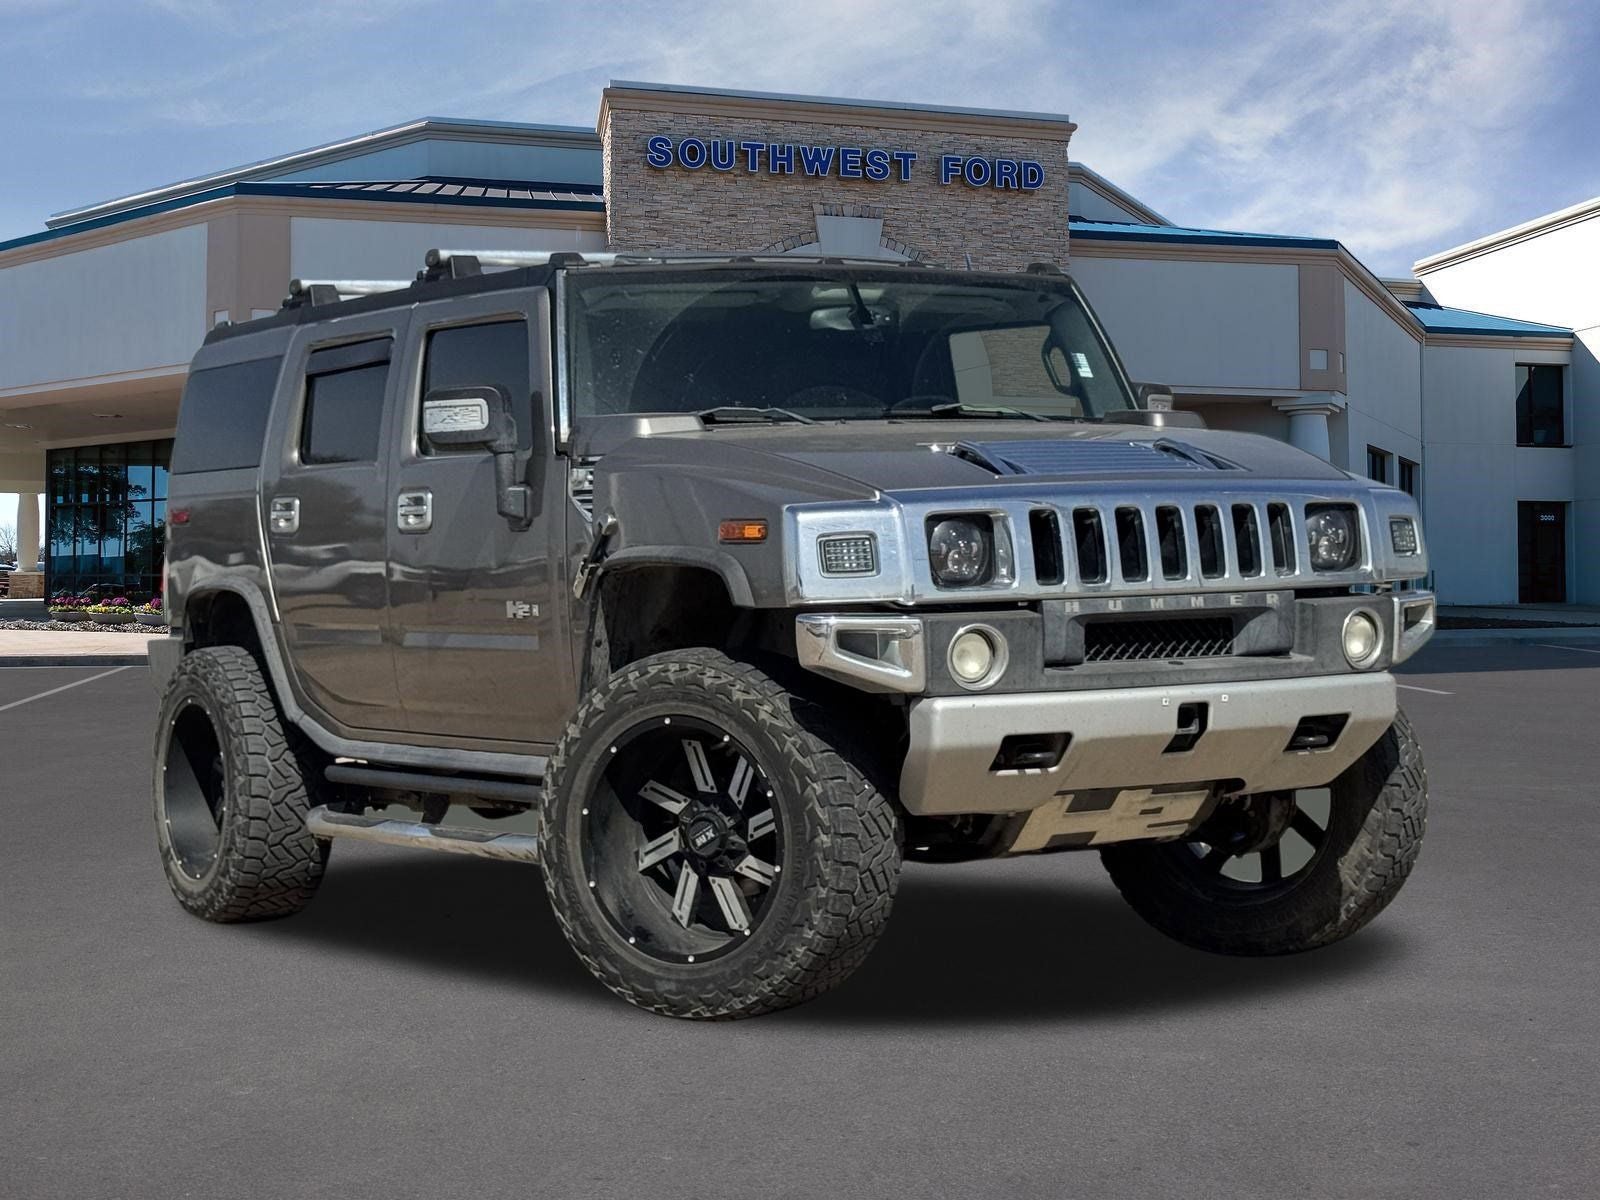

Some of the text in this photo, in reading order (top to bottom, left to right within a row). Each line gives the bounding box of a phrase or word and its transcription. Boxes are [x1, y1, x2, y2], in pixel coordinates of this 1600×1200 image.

[646, 135, 1046, 190] SOUTHWEST FORD
[1064, 593, 1282, 613] HUMMER
